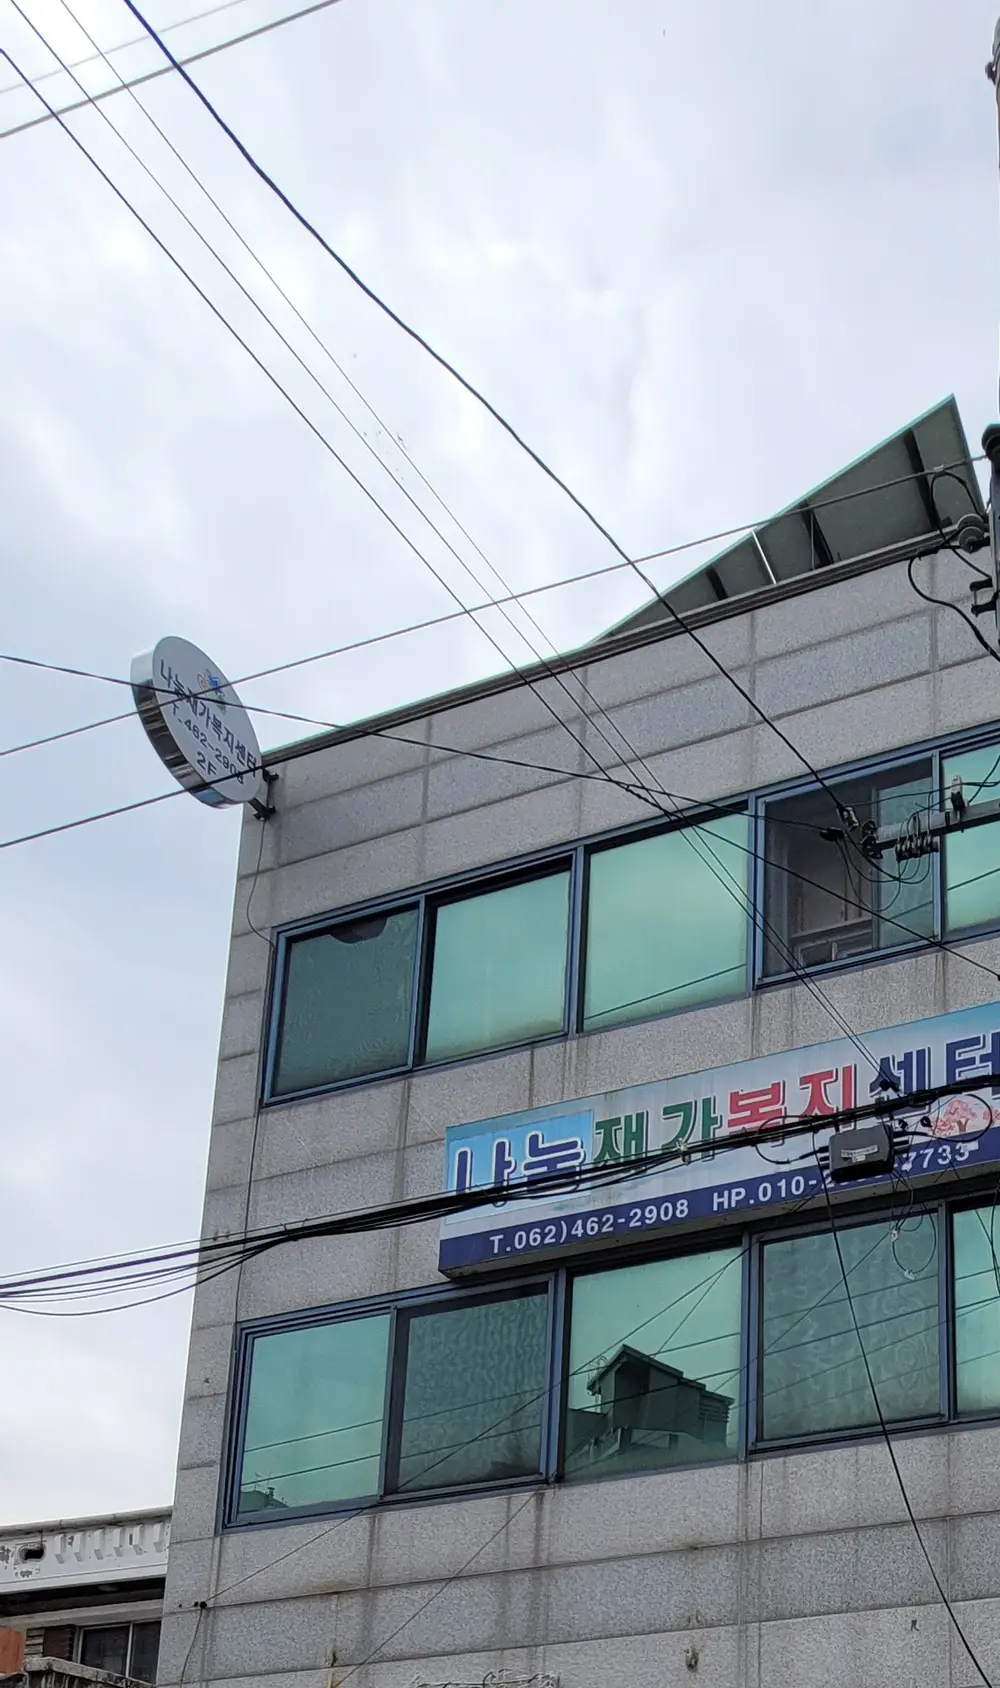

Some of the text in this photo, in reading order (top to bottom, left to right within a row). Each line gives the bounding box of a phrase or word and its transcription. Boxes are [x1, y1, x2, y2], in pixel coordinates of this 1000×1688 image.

[196, 751, 217, 776] 2F
[489, 1141, 970, 1254] T.062)462-2908 HP.010-2-7733
